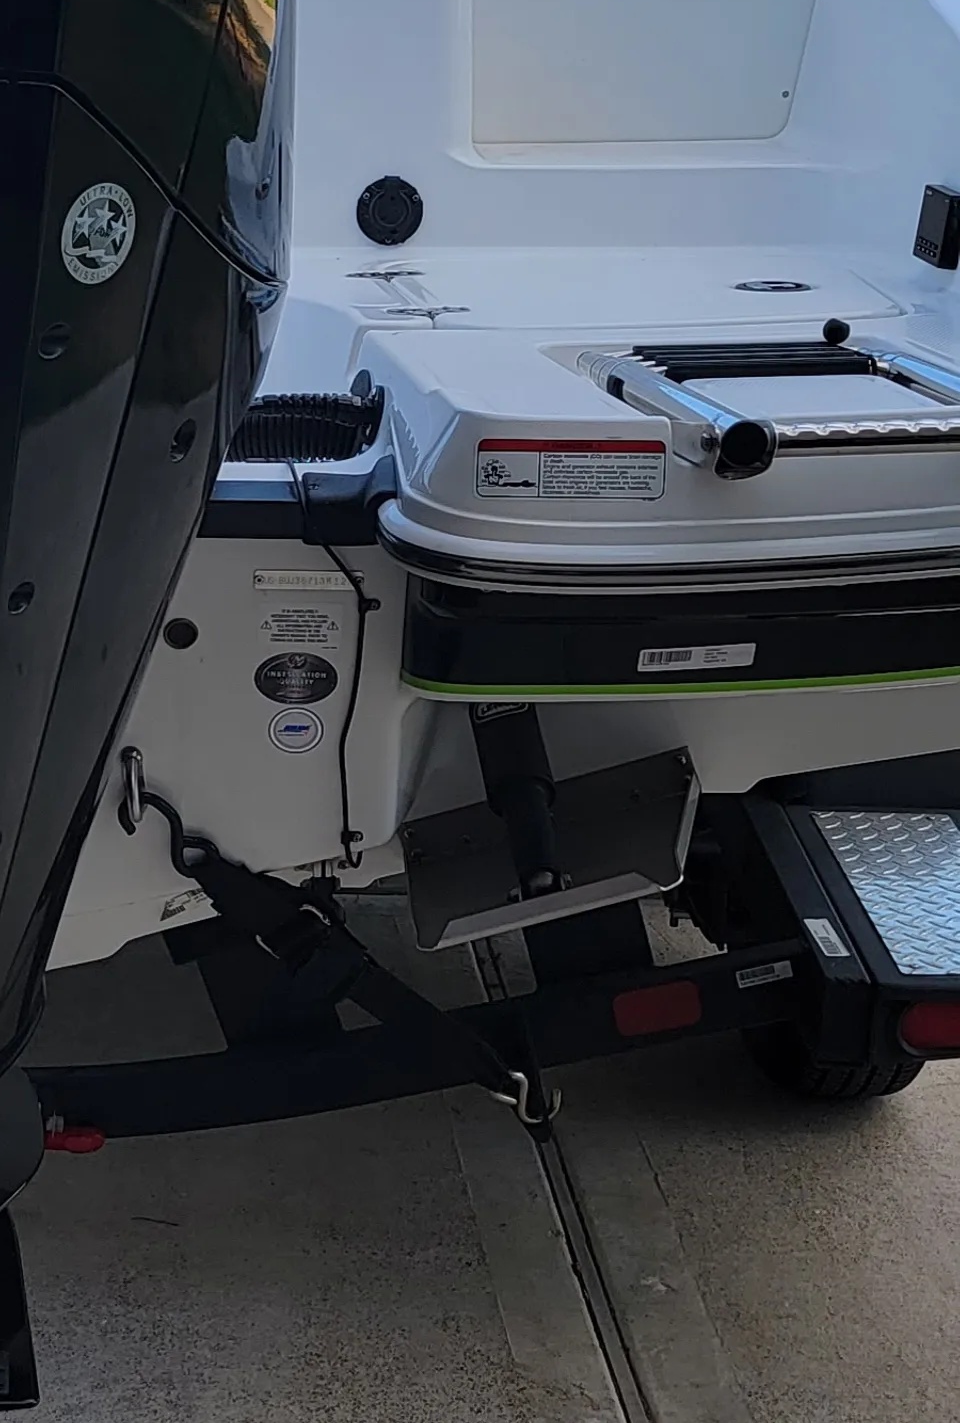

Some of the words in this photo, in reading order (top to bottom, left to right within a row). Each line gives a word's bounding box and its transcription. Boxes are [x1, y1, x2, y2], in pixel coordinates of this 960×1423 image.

[79, 186, 113, 207] ULTRA
[118, 192, 134, 218] LOW
[266, 670, 328, 679] INSTLATION
